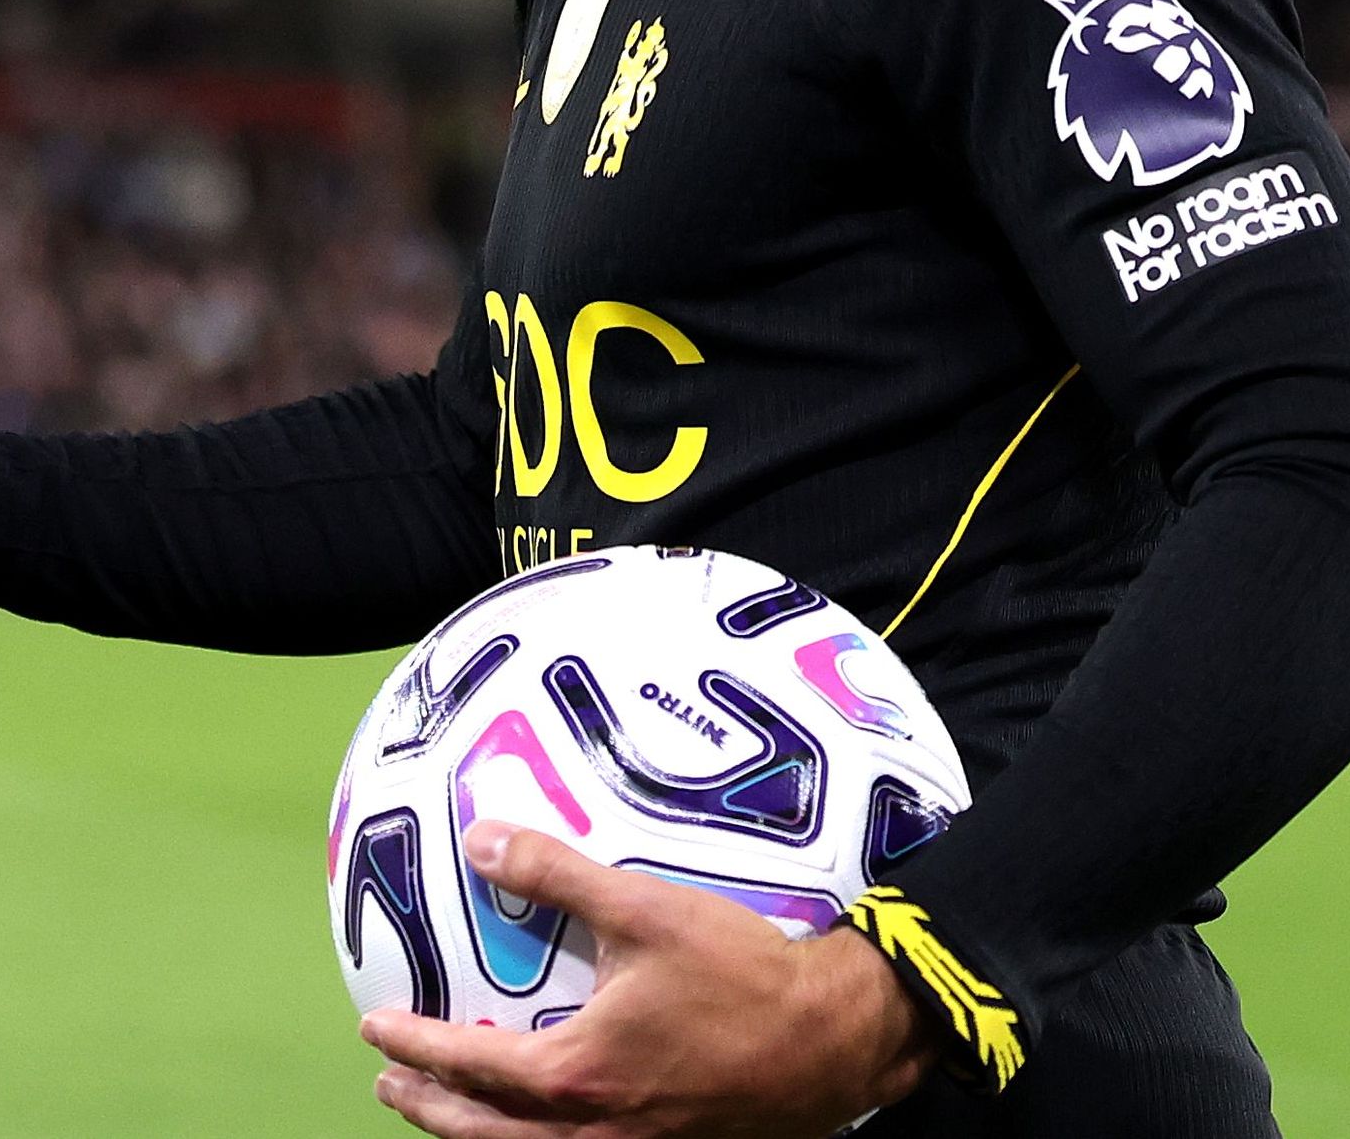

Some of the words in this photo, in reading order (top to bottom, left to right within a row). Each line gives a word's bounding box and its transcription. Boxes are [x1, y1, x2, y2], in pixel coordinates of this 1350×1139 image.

[1103, 214, 1174, 270] No
[1176, 164, 1305, 233] room
[1187, 193, 1338, 267] racism
[639, 682, 731, 751] NITRO
